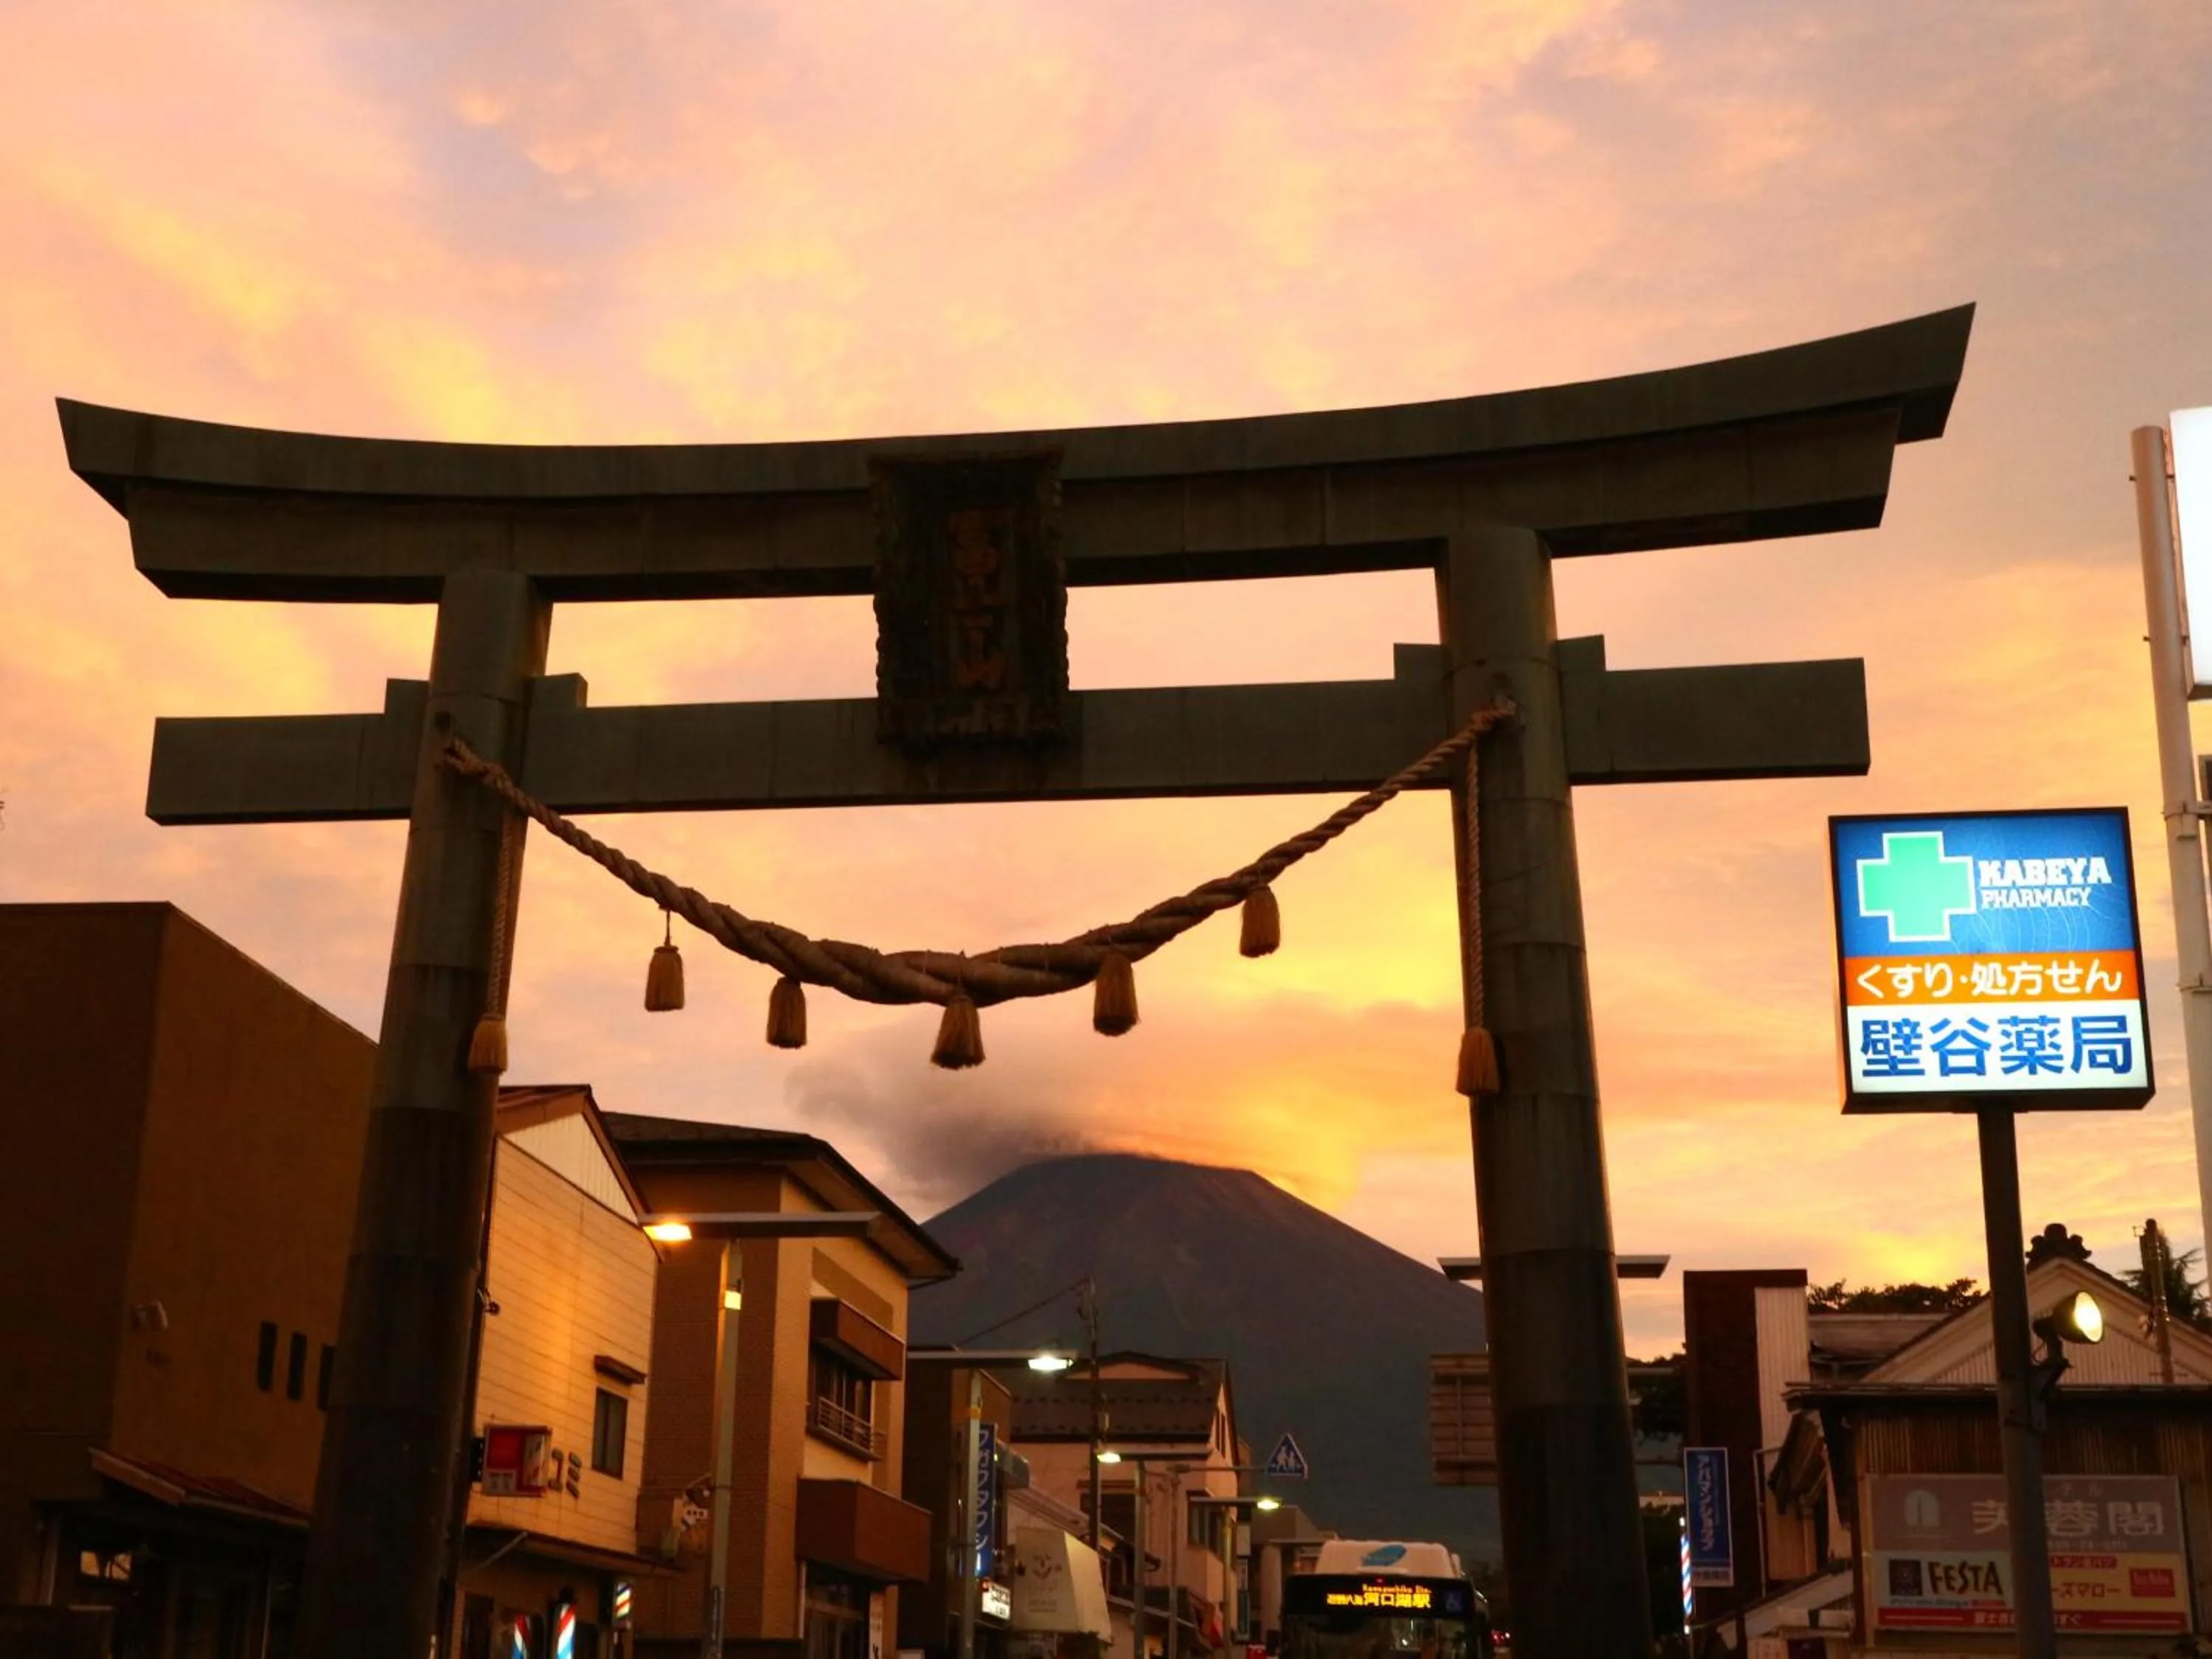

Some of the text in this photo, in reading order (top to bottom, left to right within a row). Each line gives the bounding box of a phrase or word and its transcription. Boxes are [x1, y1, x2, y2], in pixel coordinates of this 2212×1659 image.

[1978, 857, 2112, 887] KABEYA
[1980, 887, 2091, 909] PHARMACY
[1857, 959, 2122, 998] くすり・処方せん
[1860, 1015, 2133, 1077] 壁谷薬局
[1927, 1560, 2003, 1596] FESTA
